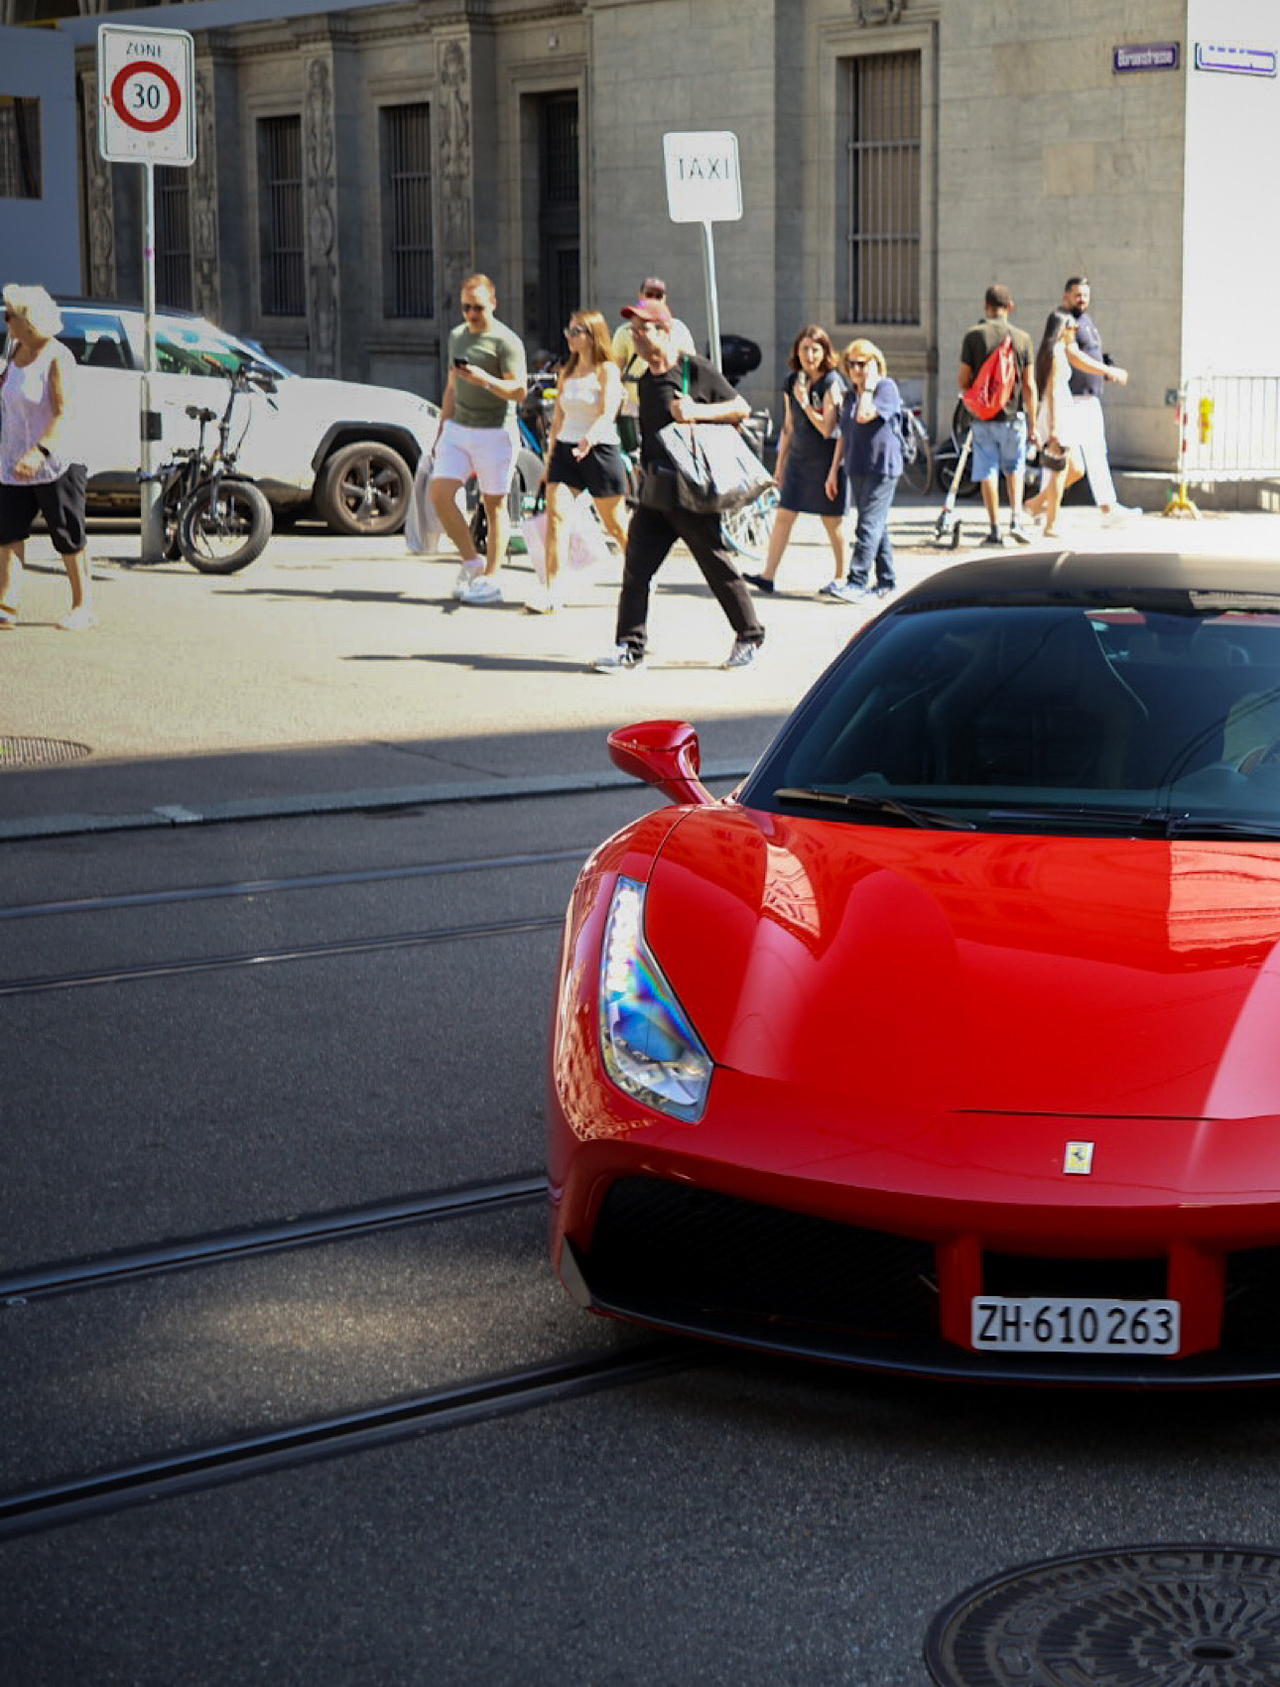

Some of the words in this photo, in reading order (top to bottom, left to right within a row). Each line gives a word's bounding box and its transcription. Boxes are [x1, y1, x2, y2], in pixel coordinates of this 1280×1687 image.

[132, 83, 161, 110] 30
[676, 156, 730, 180] TAXI
[1106, 1306, 1173, 1345] 263
